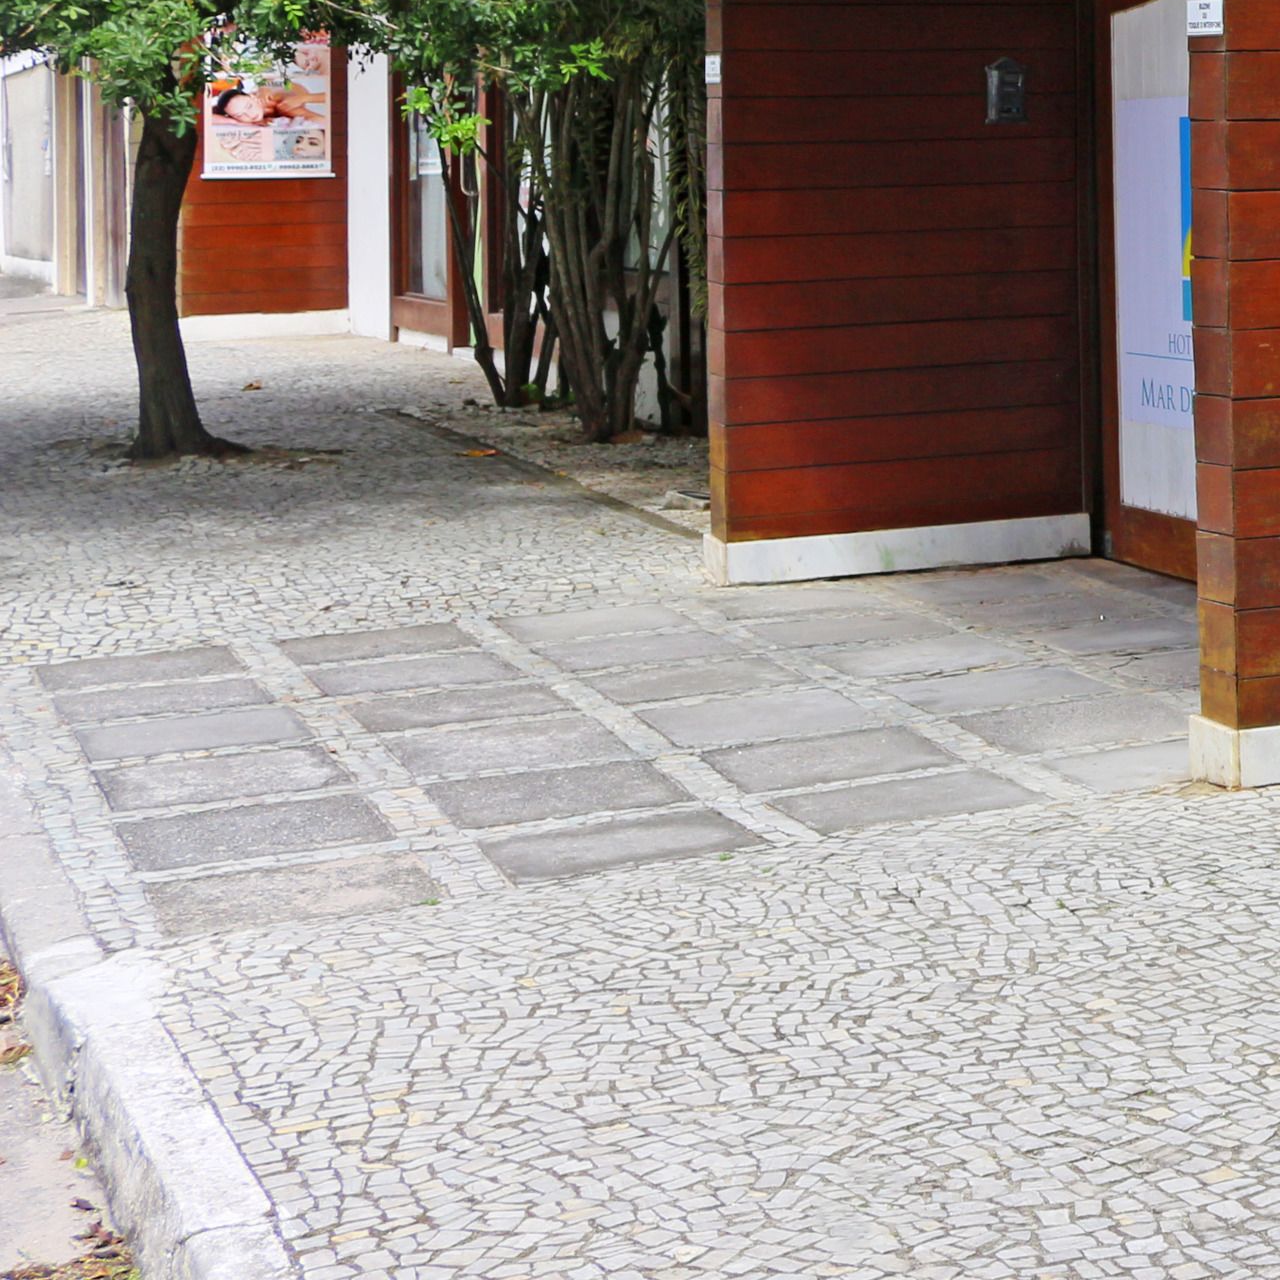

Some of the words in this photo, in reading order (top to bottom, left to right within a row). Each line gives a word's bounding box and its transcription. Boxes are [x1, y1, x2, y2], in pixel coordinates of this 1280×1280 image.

[1168, 333, 1192, 355] HOT
[1141, 377, 1177, 412] MAR
[1180, 386, 1195, 415] D
